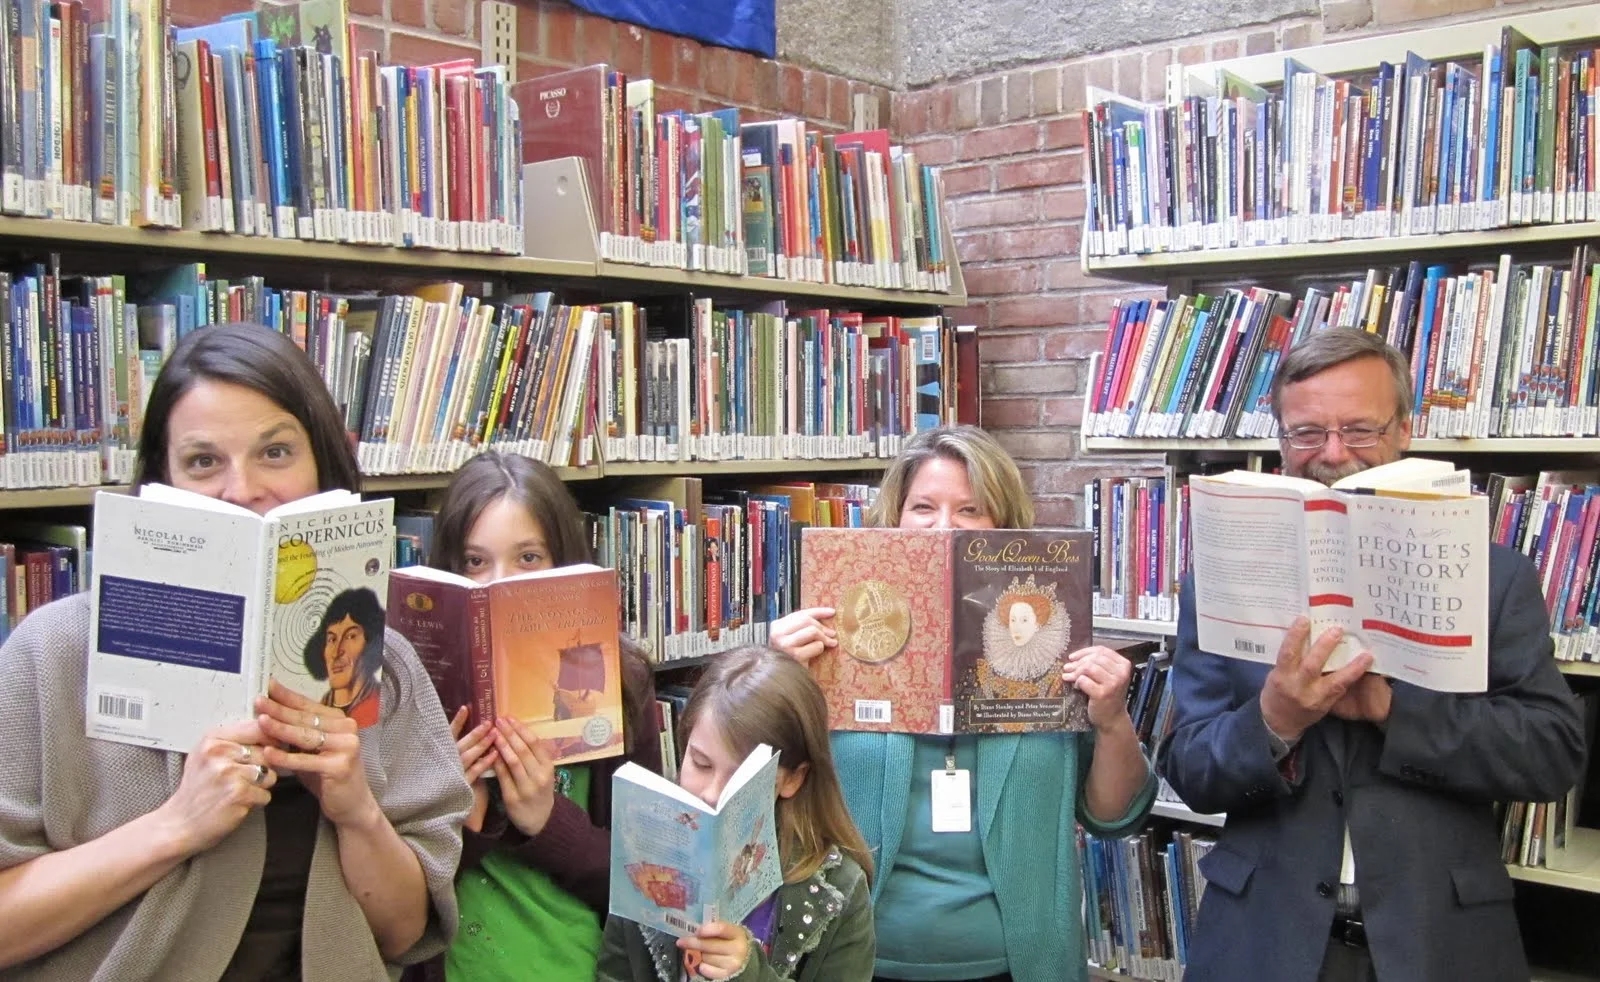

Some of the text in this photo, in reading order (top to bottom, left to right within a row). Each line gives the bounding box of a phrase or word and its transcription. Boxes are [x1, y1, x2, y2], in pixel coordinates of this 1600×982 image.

[106, 80, 115, 95] JOE
[540, 88, 567, 100] PICASSO
[107, 99, 115, 124] LOUIS
[1473, 278, 1489, 365] JONATHAN TAYLOR THOMAS
[1555, 324, 1563, 339] JIM
[400, 310, 418, 389] MARY, QUEEN OF SCOTS
[493, 318, 507, 357] WILLIE MAYS
[1141, 324, 1160, 368] TALLCHIEF
[1107, 353, 1117, 376] WILLIAM
[1226, 346, 1246, 392] ZACHARY TAYLOR
[1424, 332, 1438, 396] CLARENCE THOMAS
[509, 388, 519, 412] McCAIN
[1103, 382, 1111, 395] TAFT
[279, 508, 384, 532] NICHOLAS
[1357, 503, 1416, 516] howard
[134, 524, 183, 541] NICOLAI
[279, 518, 384, 549] COPERNICUS
[1406, 528, 1416, 539] A
[327, 547, 333, 557] of
[334, 543, 356, 553] Modern
[355, 539, 384, 550] Astronomy
[963, 538, 1080, 563] Good Queen Bess
[1358, 536, 1471, 559] PEOPLE'S
[985, 565, 1000, 573] Story
[1358, 554, 1470, 578] HISTORY
[1388, 575, 1439, 592] OF THE
[1367, 584, 1463, 612] UNITED
[1374, 603, 1457, 631] STATES
